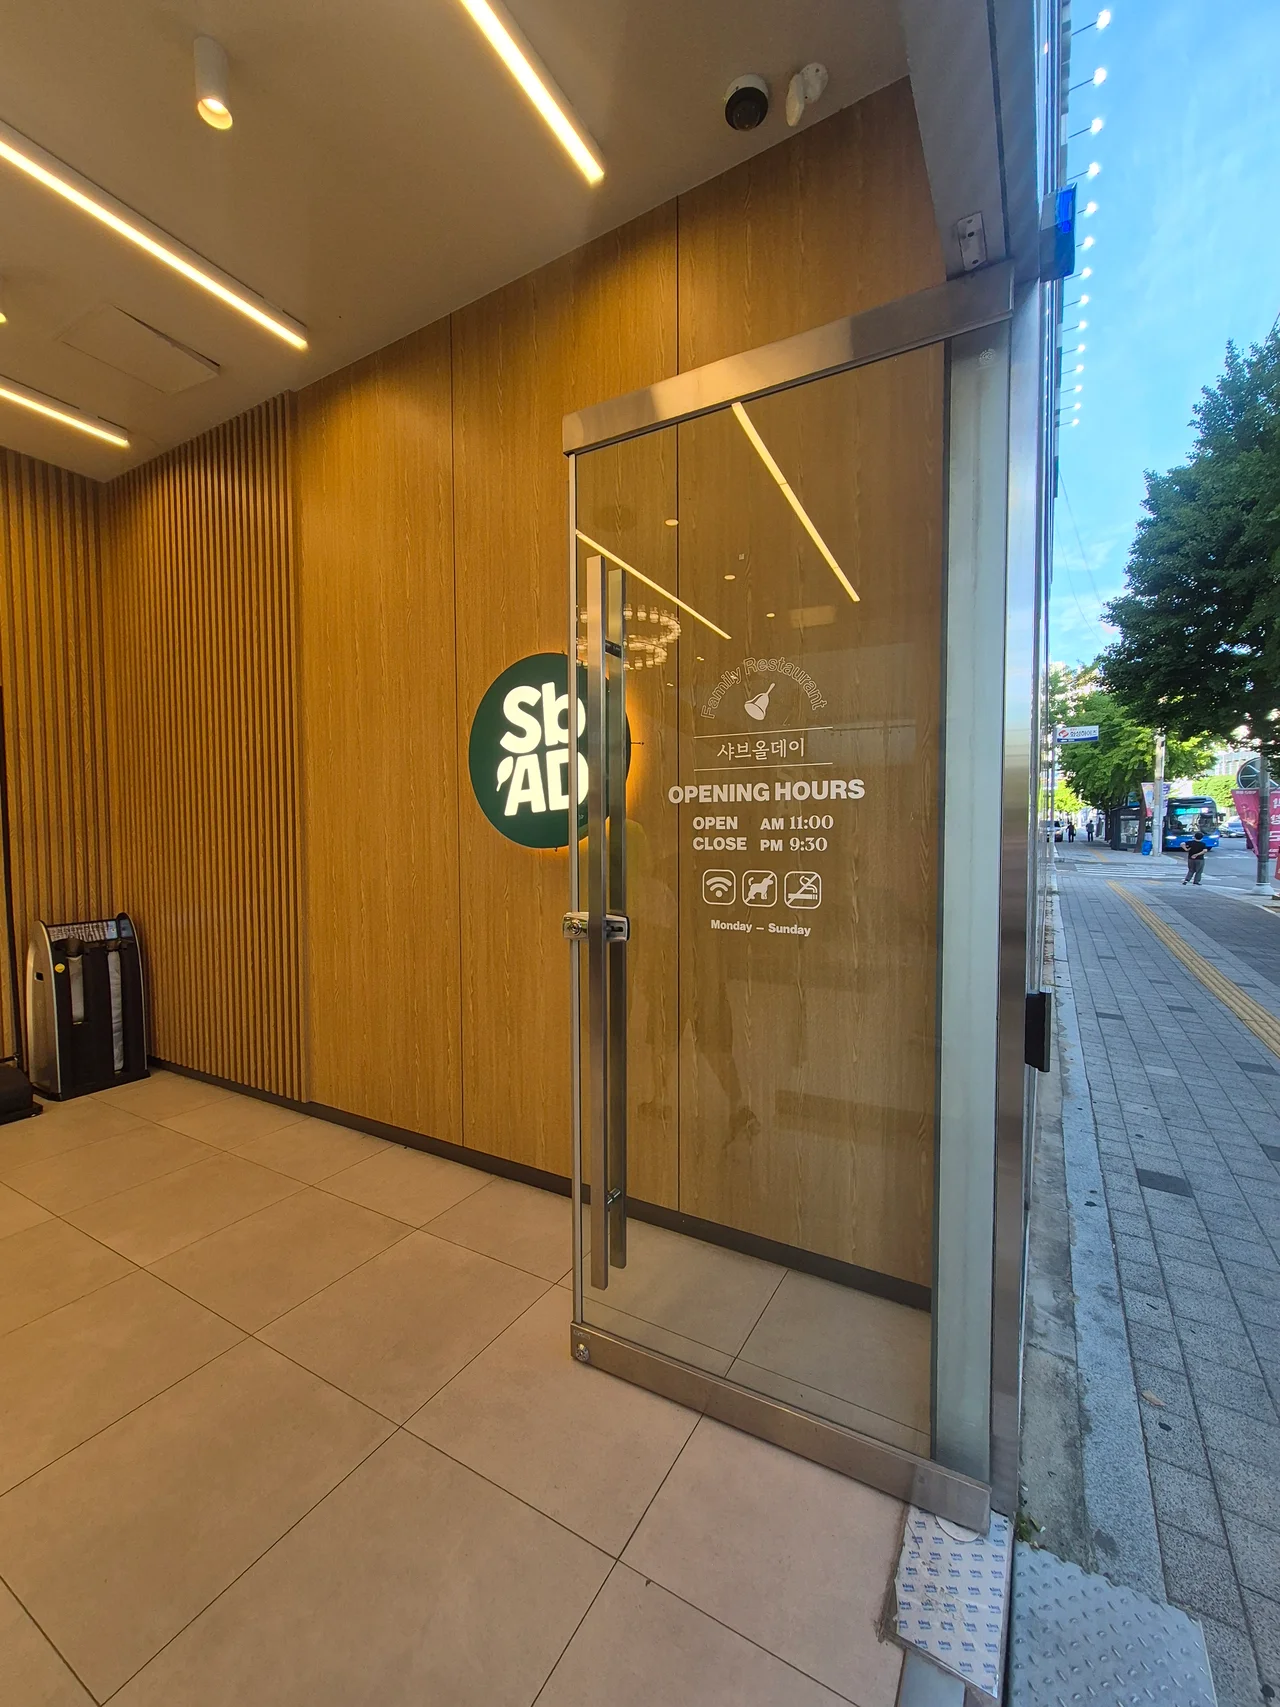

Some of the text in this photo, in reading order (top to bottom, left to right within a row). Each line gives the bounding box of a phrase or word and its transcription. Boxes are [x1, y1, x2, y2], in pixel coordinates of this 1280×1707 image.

[701, 656, 828, 720] Family Restaurant
[500, 681, 586, 754] Sb
[716, 737, 805, 761] 샤브올데이
[668, 779, 866, 804] OPENING HOURS
[692, 815, 834, 830] OPEN AM 11:00
[692, 837, 828, 852] CLOSE PM 9:30
[710, 919, 752, 933] Monday
[768, 922, 811, 937] Sunday
